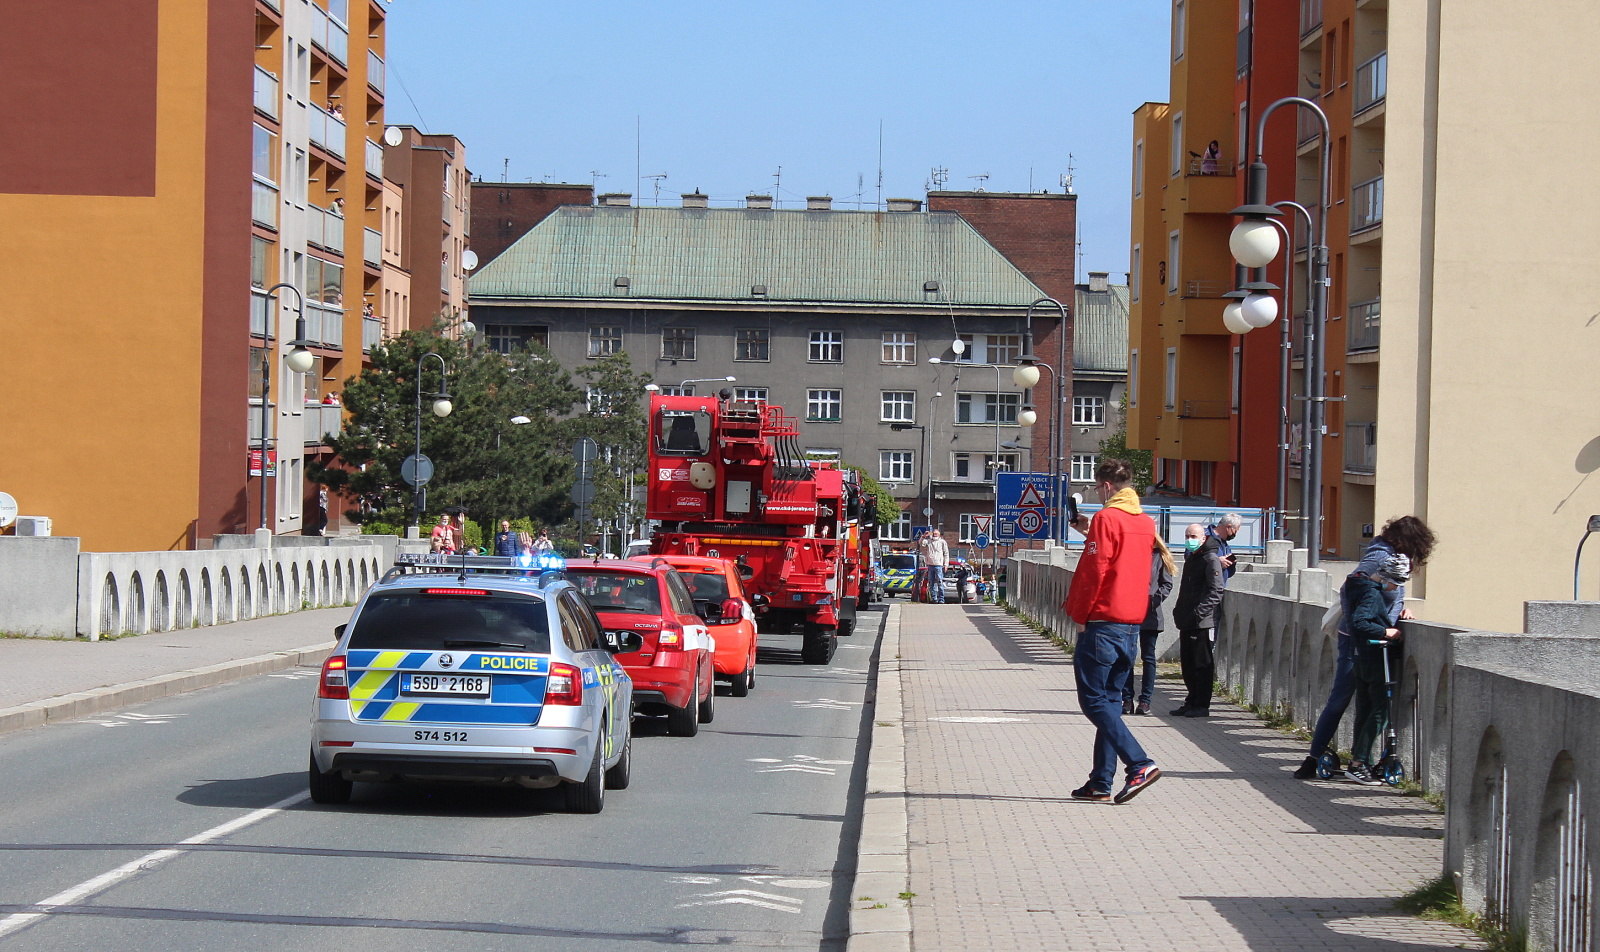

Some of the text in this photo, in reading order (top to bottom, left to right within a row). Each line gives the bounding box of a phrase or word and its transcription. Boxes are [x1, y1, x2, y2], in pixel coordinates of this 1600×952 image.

[1023, 516, 1037, 528] 30
[480, 656, 539, 671] POLICIE
[413, 676, 439, 691] 5SD
[449, 677, 483, 692] 2168
[414, 730, 468, 742] S74 512
